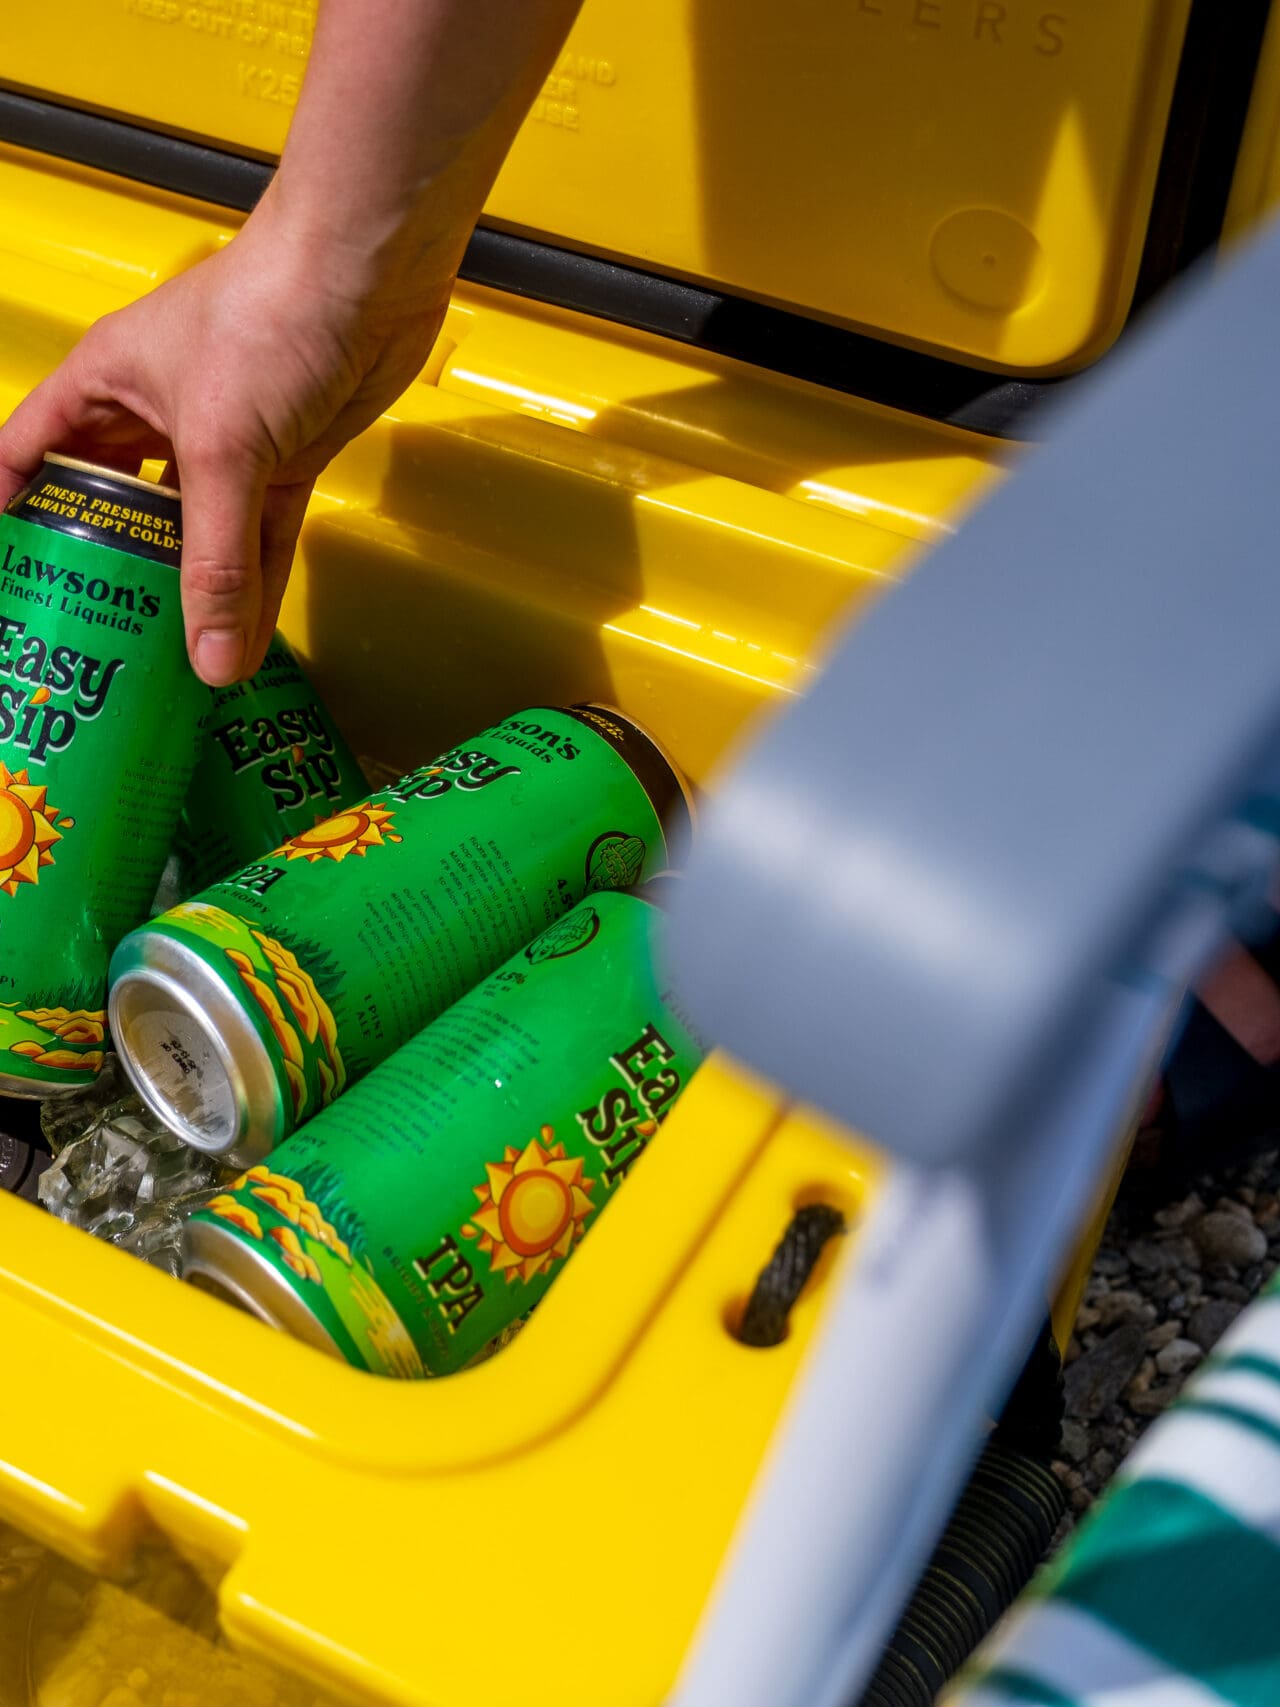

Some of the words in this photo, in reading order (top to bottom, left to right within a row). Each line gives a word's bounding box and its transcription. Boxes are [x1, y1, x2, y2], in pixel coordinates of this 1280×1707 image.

[26, 495, 78, 520] ALWAYS
[80, 511, 126, 535] KEPT
[40, 484, 87, 507] FINEST.
[90, 498, 177, 535] FRESHEST.
[0, 576, 54, 609] Finest
[60, 594, 145, 636] Liquids
[1, 545, 161, 619] Lawson's
[212, 704, 335, 775] Easy
[491, 731, 555, 764] Liquids
[261, 753, 342, 813] Sip
[412, 1233, 485, 1335] IPA
